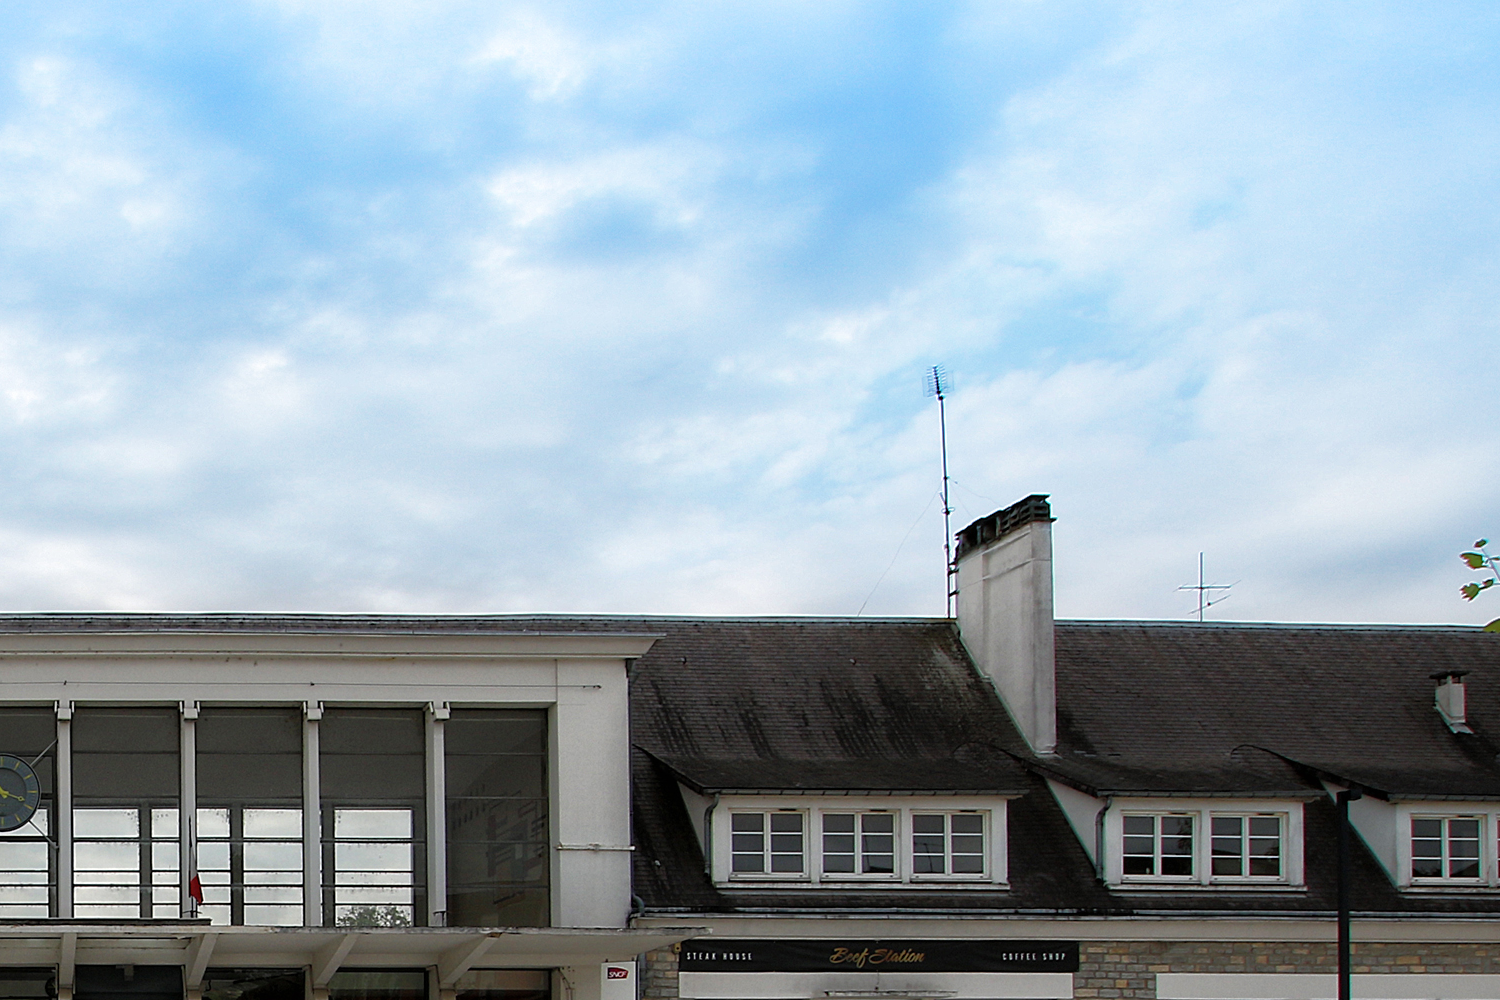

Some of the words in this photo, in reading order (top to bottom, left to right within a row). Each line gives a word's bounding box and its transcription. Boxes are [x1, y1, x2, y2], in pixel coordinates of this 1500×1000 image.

[686, 952, 717, 961] STEAK
[722, 952, 752, 961] HOUSE
[829, 947, 870, 969] Beef
[868, 948, 925, 965] Station
[1002, 952, 1037, 961] COFFEE
[1042, 952, 1066, 961] SHOP
